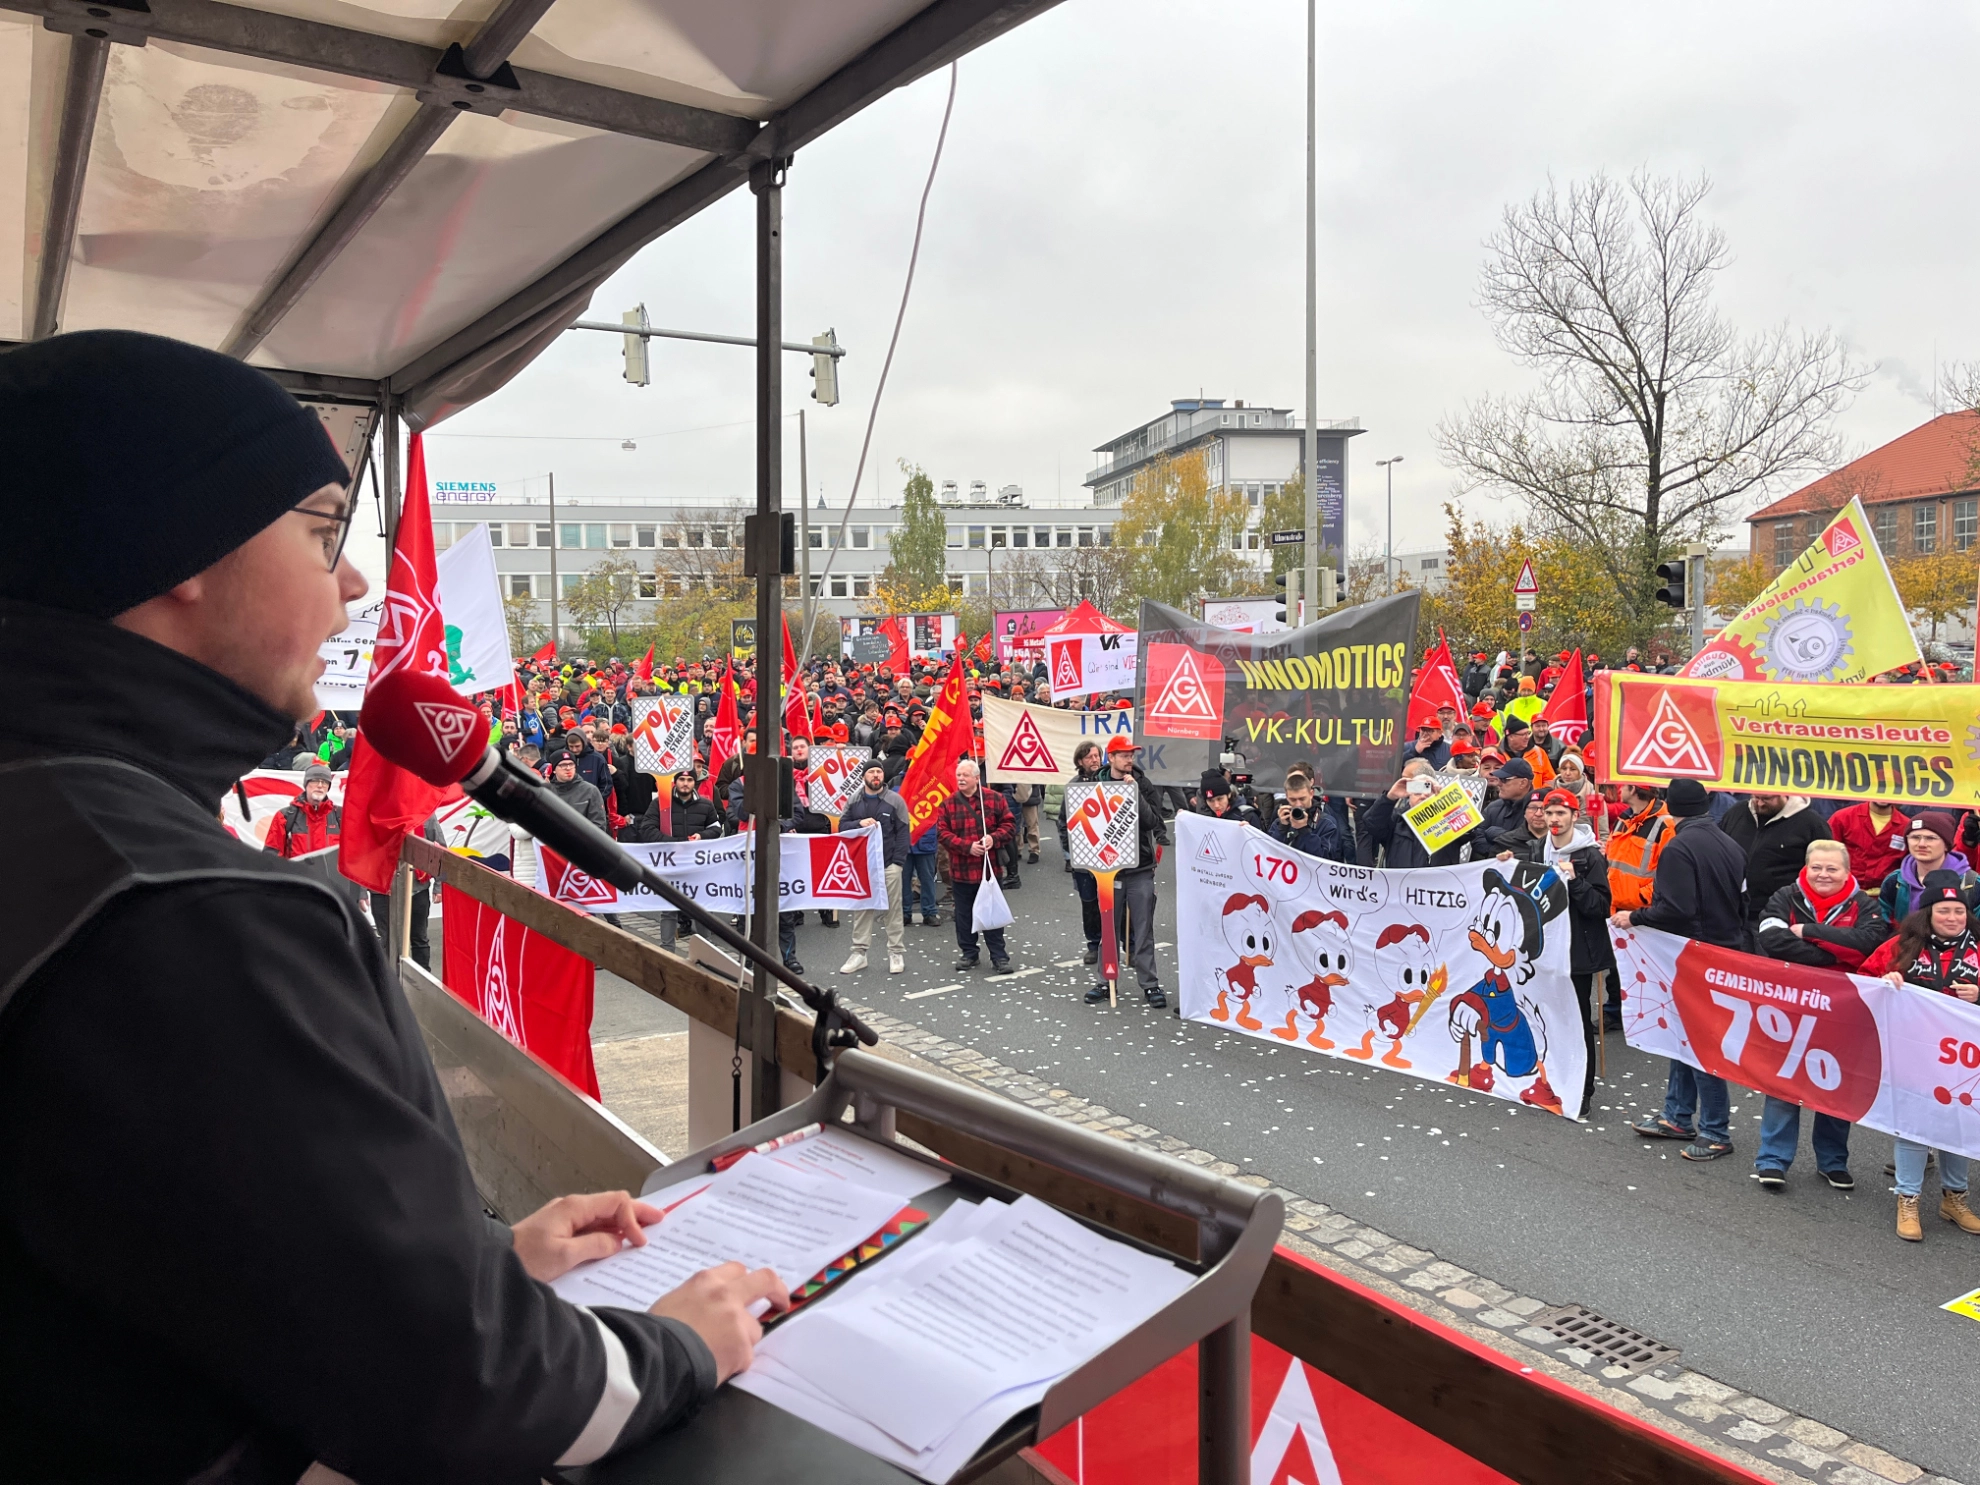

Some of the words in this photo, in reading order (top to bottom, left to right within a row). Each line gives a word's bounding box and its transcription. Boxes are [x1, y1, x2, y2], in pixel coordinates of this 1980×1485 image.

[436, 482, 496, 491] SIEMENS
[1099, 634, 1124, 650] VK
[1235, 642, 1406, 690] INNOMOTICS
[663, 730, 677, 748] AUF
[673, 709, 691, 732] EINEN
[669, 721, 692, 753] STREICH
[1167, 726, 1199, 736] Nürnberg
[1246, 718, 1394, 746] VK-KULTUR
[1730, 717, 1951, 743] Vertrauensleute
[840, 778, 853, 793] AUF
[1733, 744, 1954, 797] INNOMOTICS
[1103, 821, 1118, 842] AUF
[1114, 797, 1134, 824] EINEN
[1411, 788, 1463, 827] INNOMOTICS
[1110, 812, 1136, 847] STREICH
[649, 851, 676, 867] VK
[1254, 854, 1298, 885] 170
[1406, 887, 1467, 908] HITZIG
[1704, 968, 1798, 1004] GEMEINSAM
[1800, 989, 1832, 1012] FÜR
[1710, 989, 1842, 1091] 7%
[1938, 1037, 1980, 1069] SO
